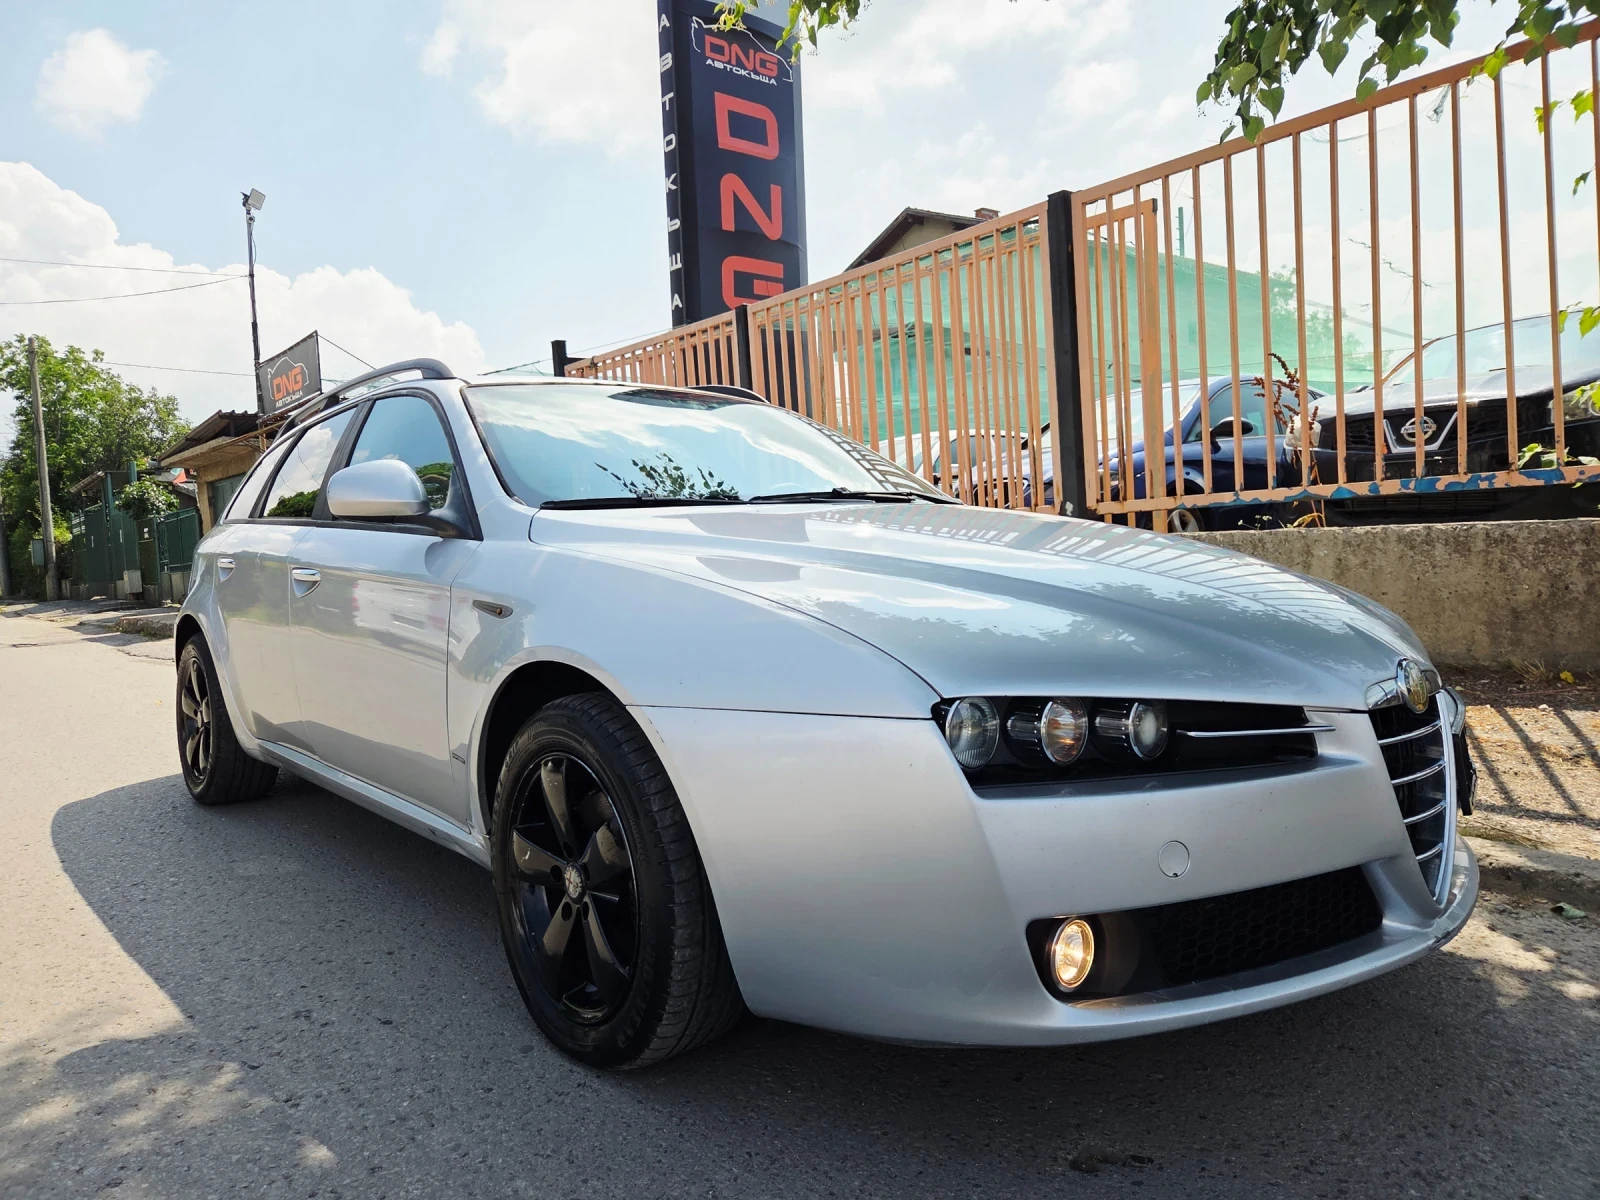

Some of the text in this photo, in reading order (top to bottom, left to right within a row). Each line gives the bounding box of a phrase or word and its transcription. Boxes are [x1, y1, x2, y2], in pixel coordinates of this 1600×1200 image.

[704, 35, 778, 77] DNG
[705, 58, 778, 86] АВТОКЪЩА
[714, 92, 784, 311] DNG
[272, 366, 303, 401] DNG
